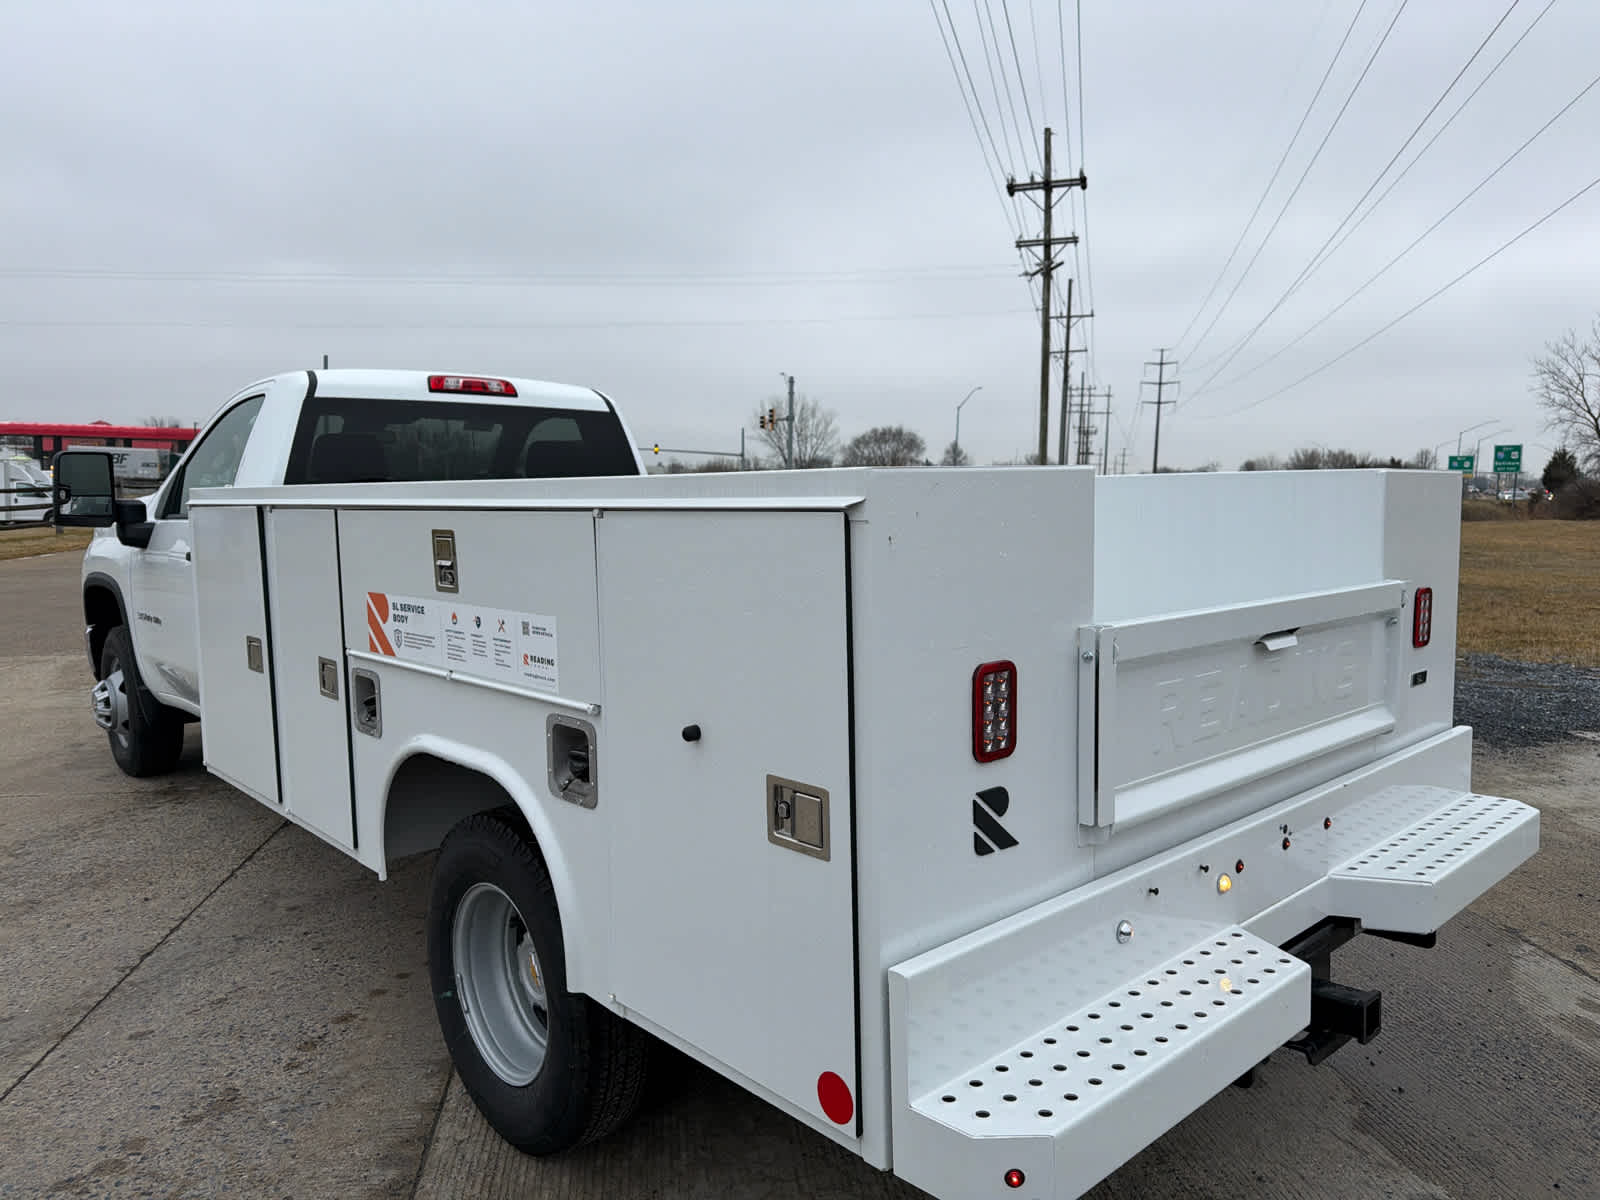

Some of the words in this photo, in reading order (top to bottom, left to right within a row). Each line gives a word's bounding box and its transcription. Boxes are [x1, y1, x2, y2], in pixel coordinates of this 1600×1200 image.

[392, 602, 399, 611] SL
[400, 603, 425, 614] SERVICE
[393, 613, 408, 624] BODY
[530, 655, 554, 666] READING
